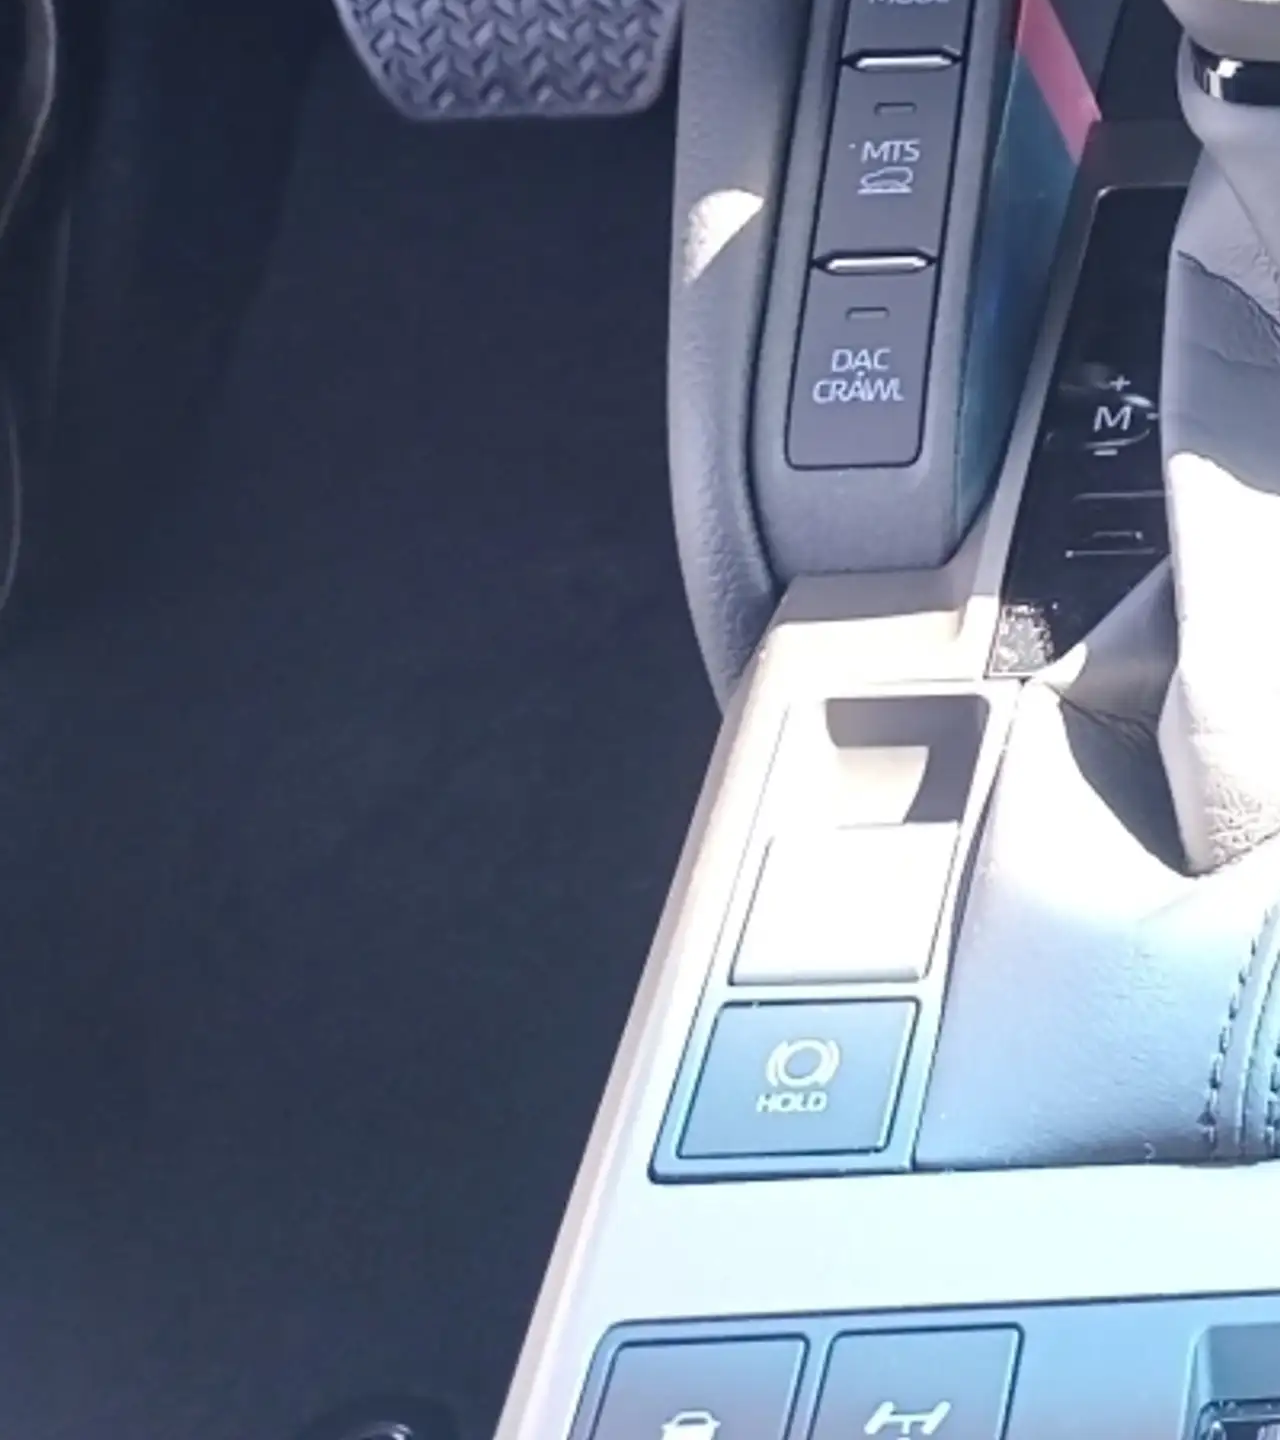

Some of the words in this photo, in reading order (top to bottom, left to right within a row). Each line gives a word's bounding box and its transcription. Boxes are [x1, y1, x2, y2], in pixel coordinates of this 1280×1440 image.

[862, 141, 920, 162] MTS
[831, 350, 891, 373] DAC
[812, 379, 905, 403] CRAWL
[756, 1093, 828, 1113] HOLD
